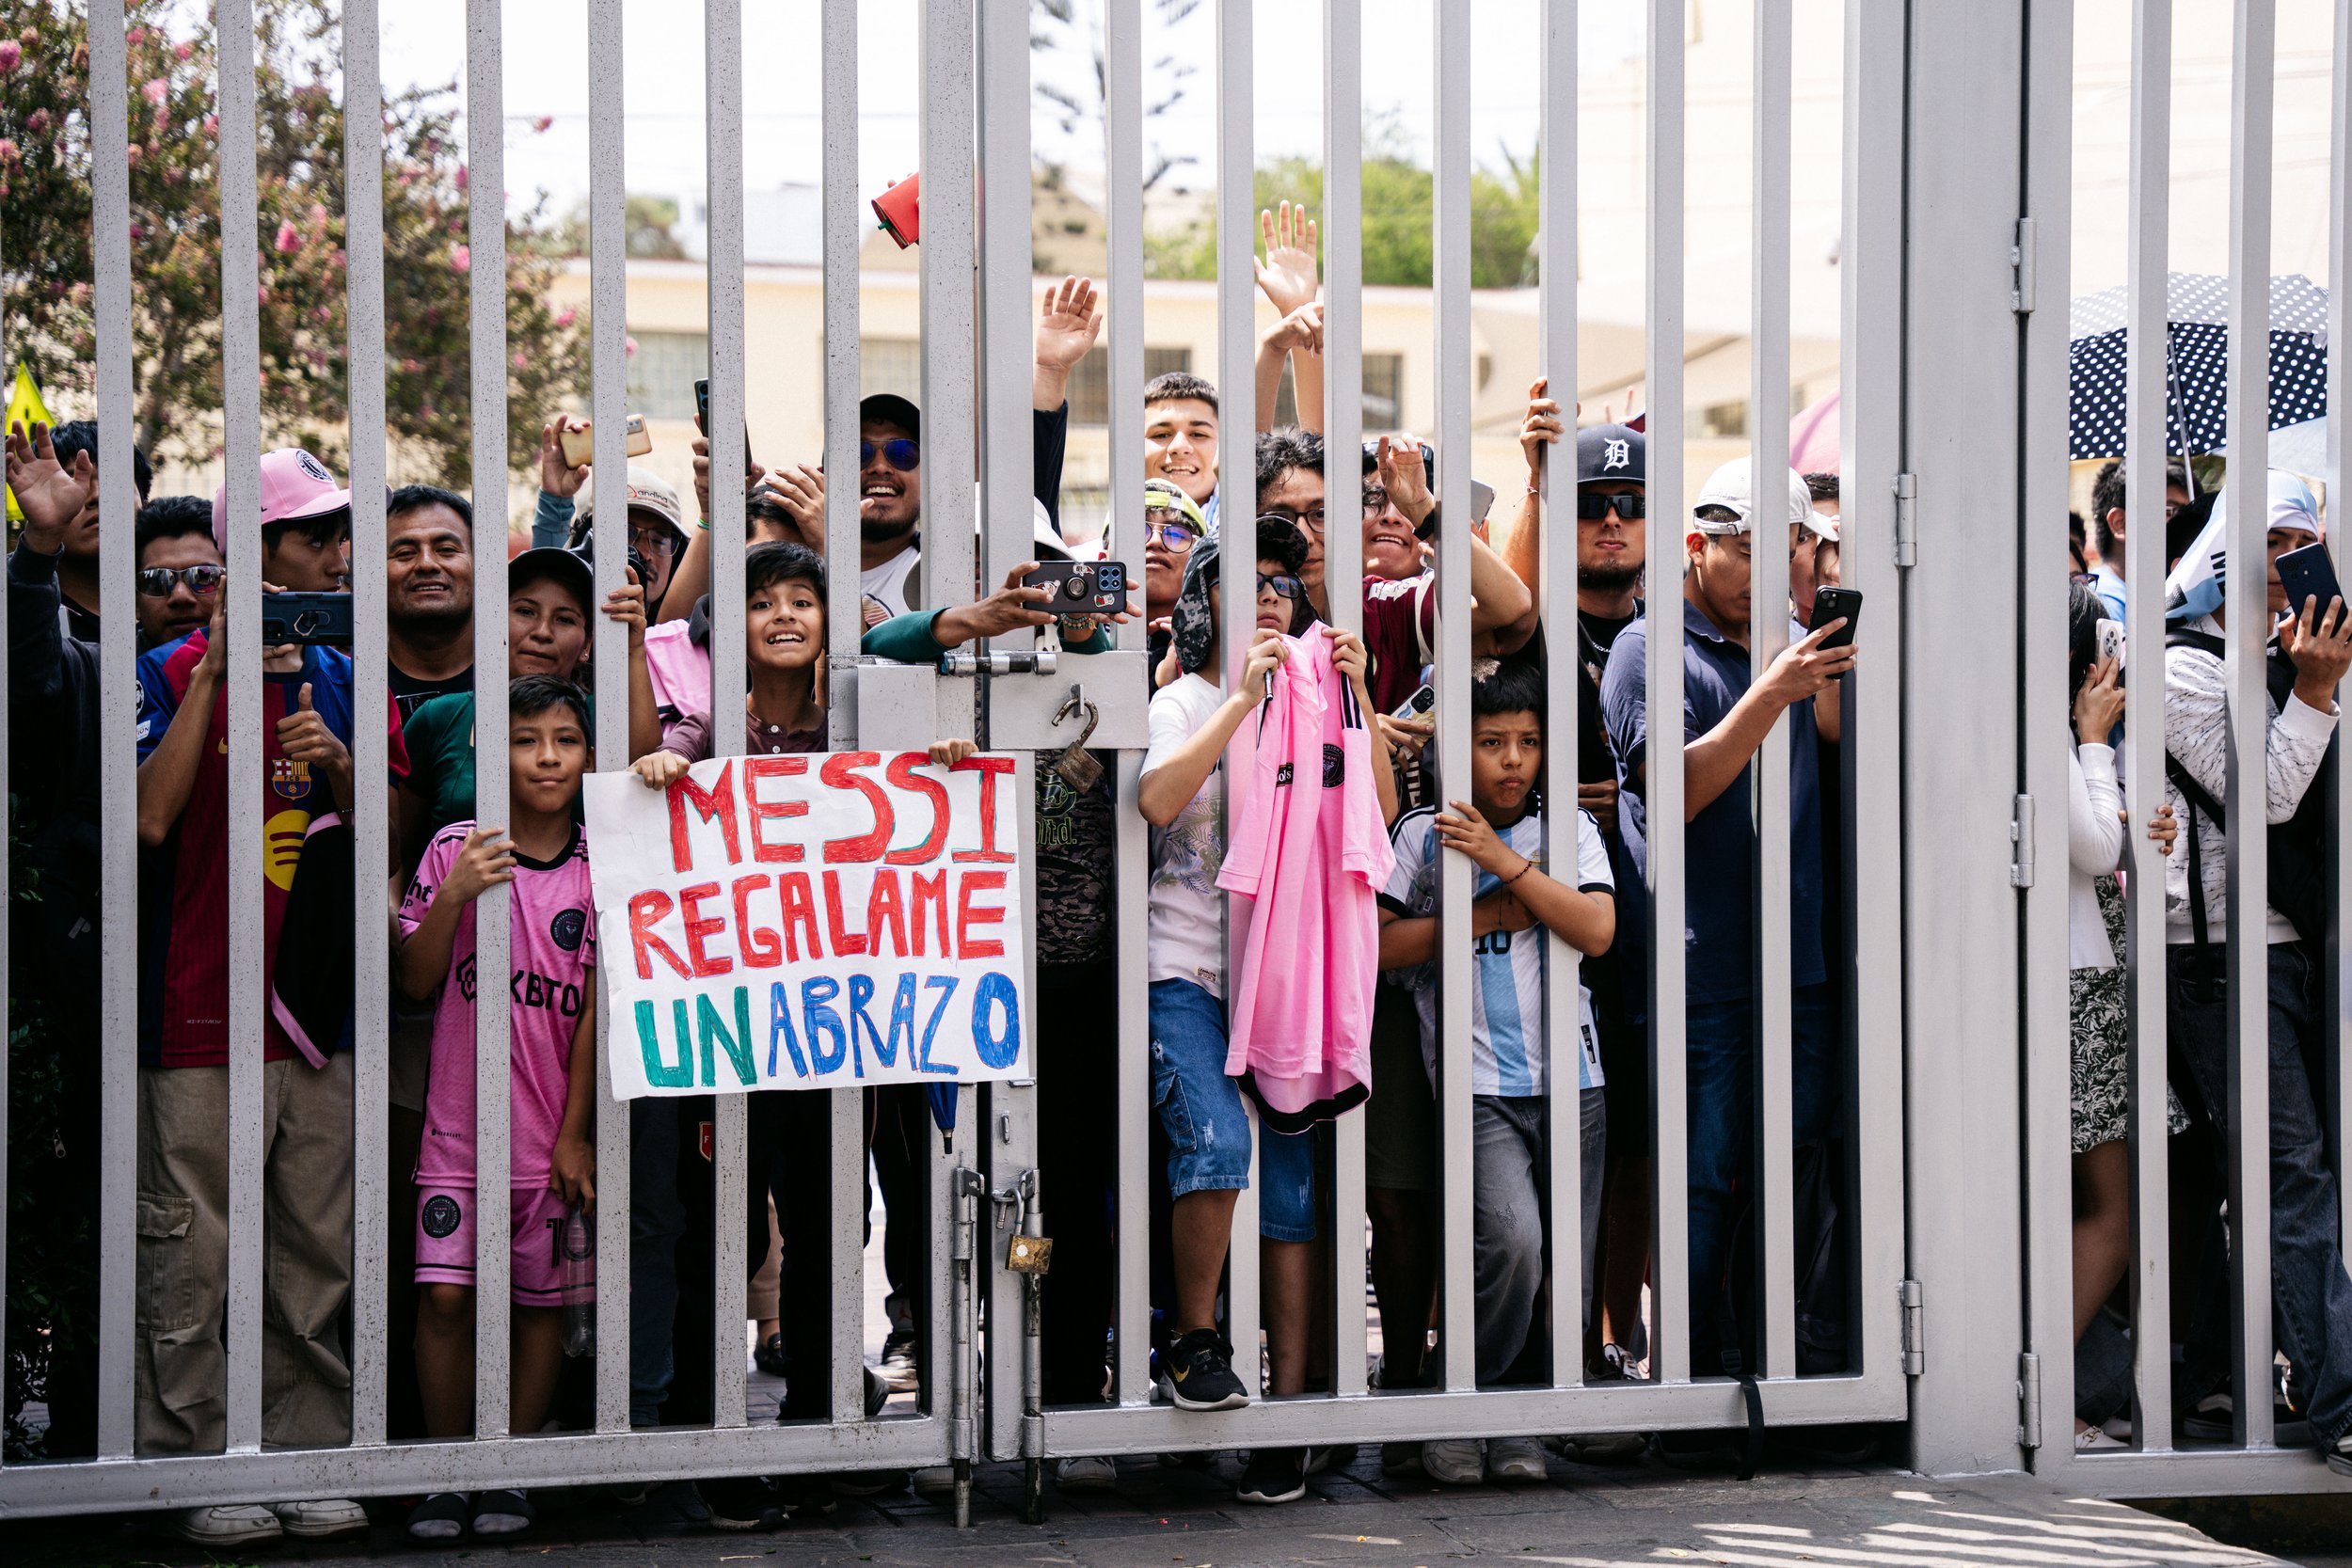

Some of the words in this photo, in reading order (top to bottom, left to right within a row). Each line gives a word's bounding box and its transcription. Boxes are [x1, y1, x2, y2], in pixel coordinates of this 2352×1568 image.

[1603, 437, 1630, 472] D
[665, 752, 1016, 873] MESSI
[628, 866, 1008, 981] REGALAME
[633, 985, 757, 1088] UN
[767, 971, 1022, 1079] ABRAZO
